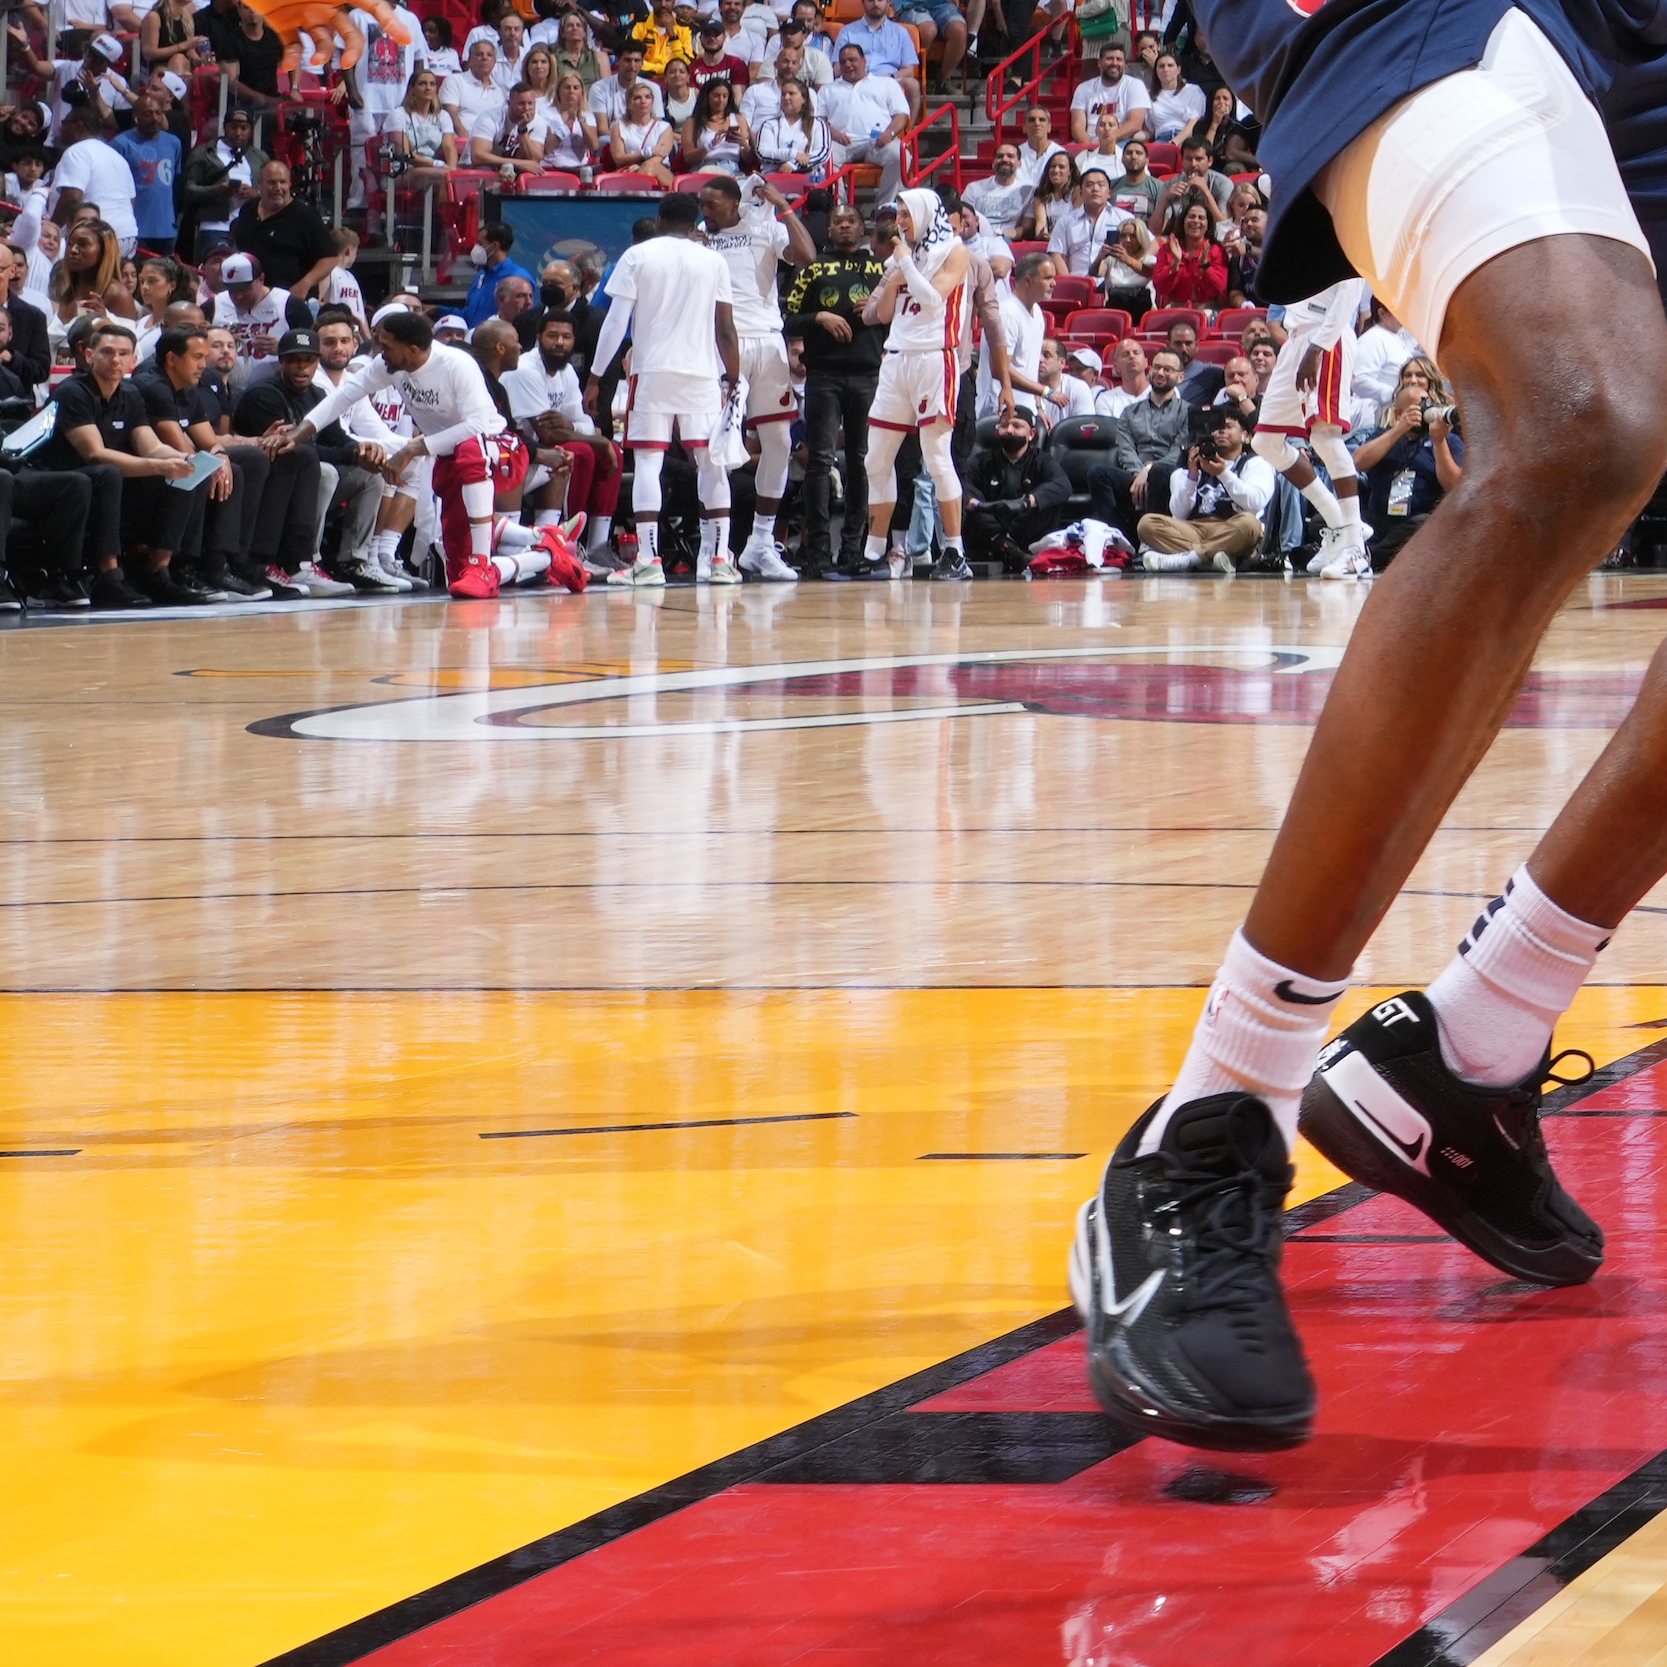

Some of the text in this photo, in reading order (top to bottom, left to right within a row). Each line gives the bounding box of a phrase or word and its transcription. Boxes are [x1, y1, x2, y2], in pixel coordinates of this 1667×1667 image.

[139, 158, 173, 186] 76
[787, 260, 841, 314] ARKET
[1370, 996, 1421, 1029] GT
